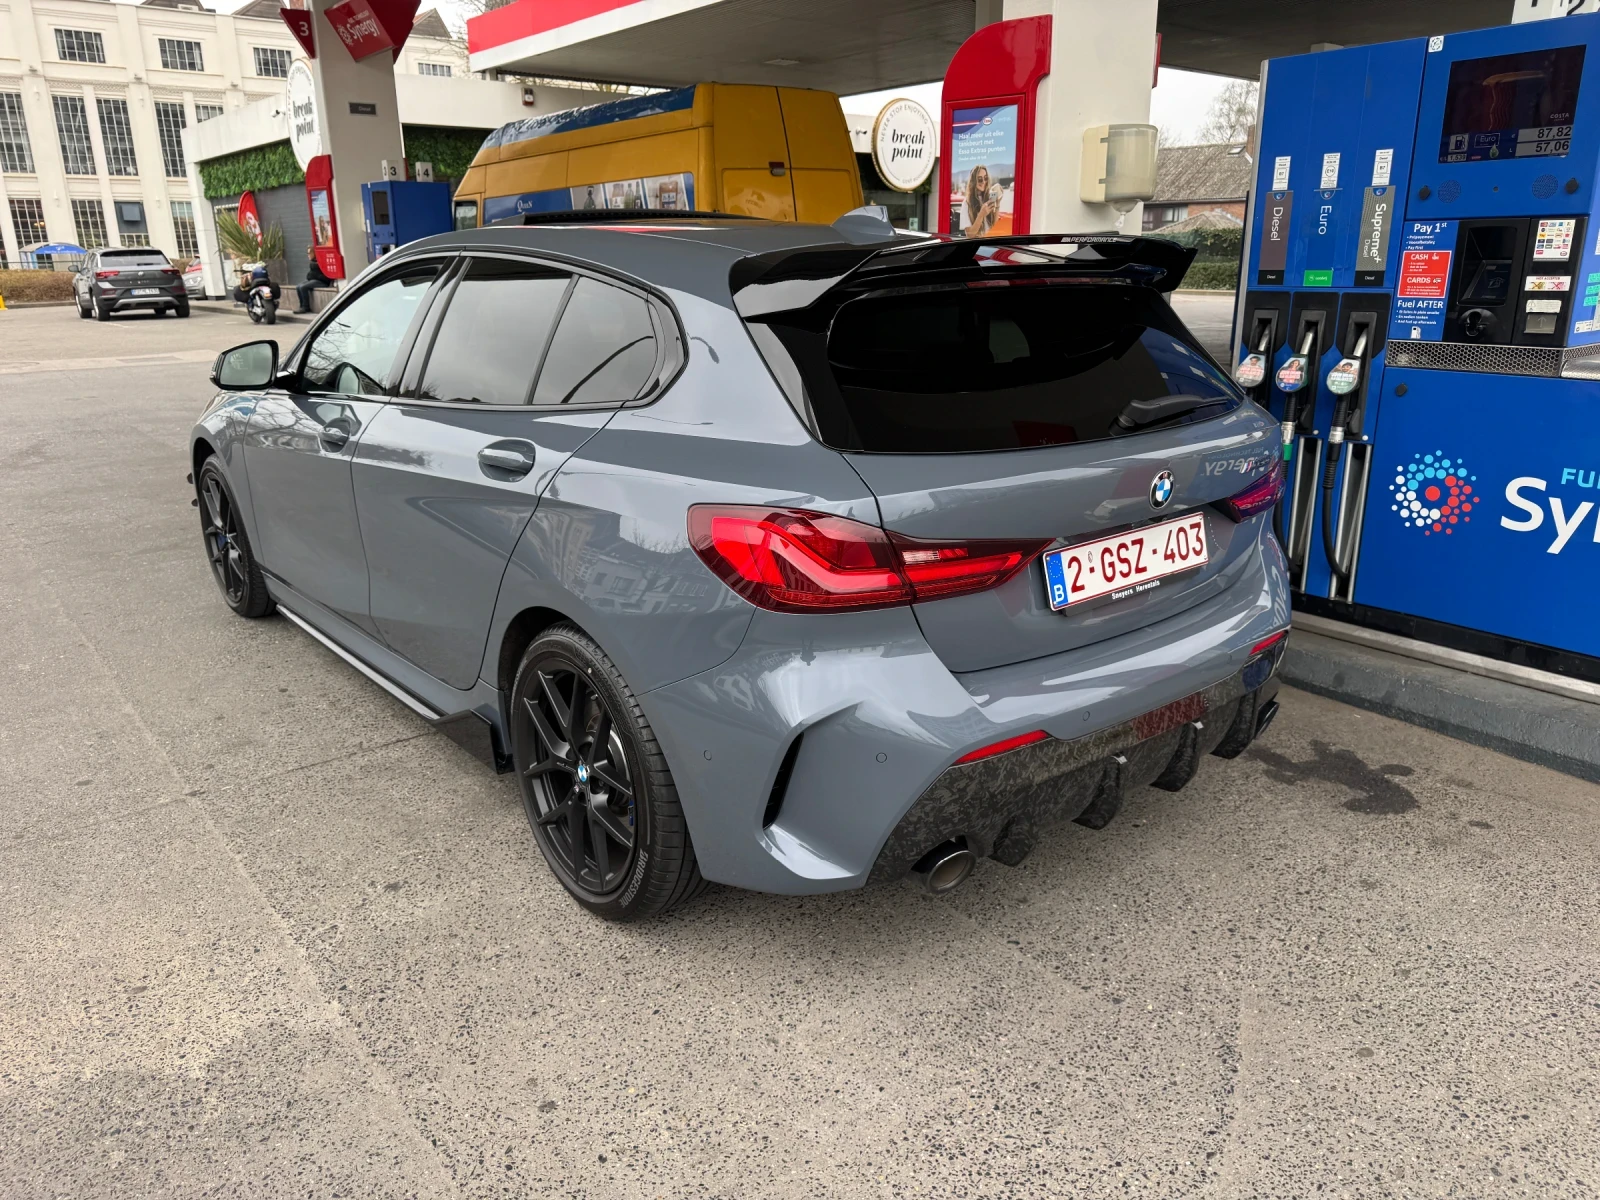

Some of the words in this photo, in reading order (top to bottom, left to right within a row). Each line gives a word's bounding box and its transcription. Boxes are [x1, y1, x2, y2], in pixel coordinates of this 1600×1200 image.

[299, 21, 309, 36] 3
[347, 18, 380, 42] Synergy
[293, 96, 313, 118] break
[881, 117, 890, 142] NEVER
[890, 105, 903, 118] STOP
[904, 104, 928, 125] ENJOYING
[892, 129, 925, 145] break
[958, 132, 970, 140] Haal
[1480, 135, 1496, 143] Euro
[1537, 126, 1572, 140] 87,82
[892, 145, 923, 162] point
[970, 146, 987, 154] Extras
[988, 146, 1006, 154] punten
[1535, 141, 1570, 154] 57,06
[391, 166, 397, 176] 3
[424, 168, 430, 177] 4
[1270, 206, 1284, 241] Diesel
[1318, 205, 1332, 235] Euro
[1370, 203, 1387, 263] Supreme+
[1414, 223, 1433, 235] Pay
[1363, 239, 1371, 258] Diesel
[1397, 299, 1416, 308] Fuel
[1417, 301, 1444, 309] AFTER
[1561, 467, 1600, 489] FU
[1500, 476, 1600, 554] Sy
[1053, 584, 1064, 602] B
[1135, 580, 1160, 592] Herentals
[619, 848, 649, 908] BRIDGESTONE
